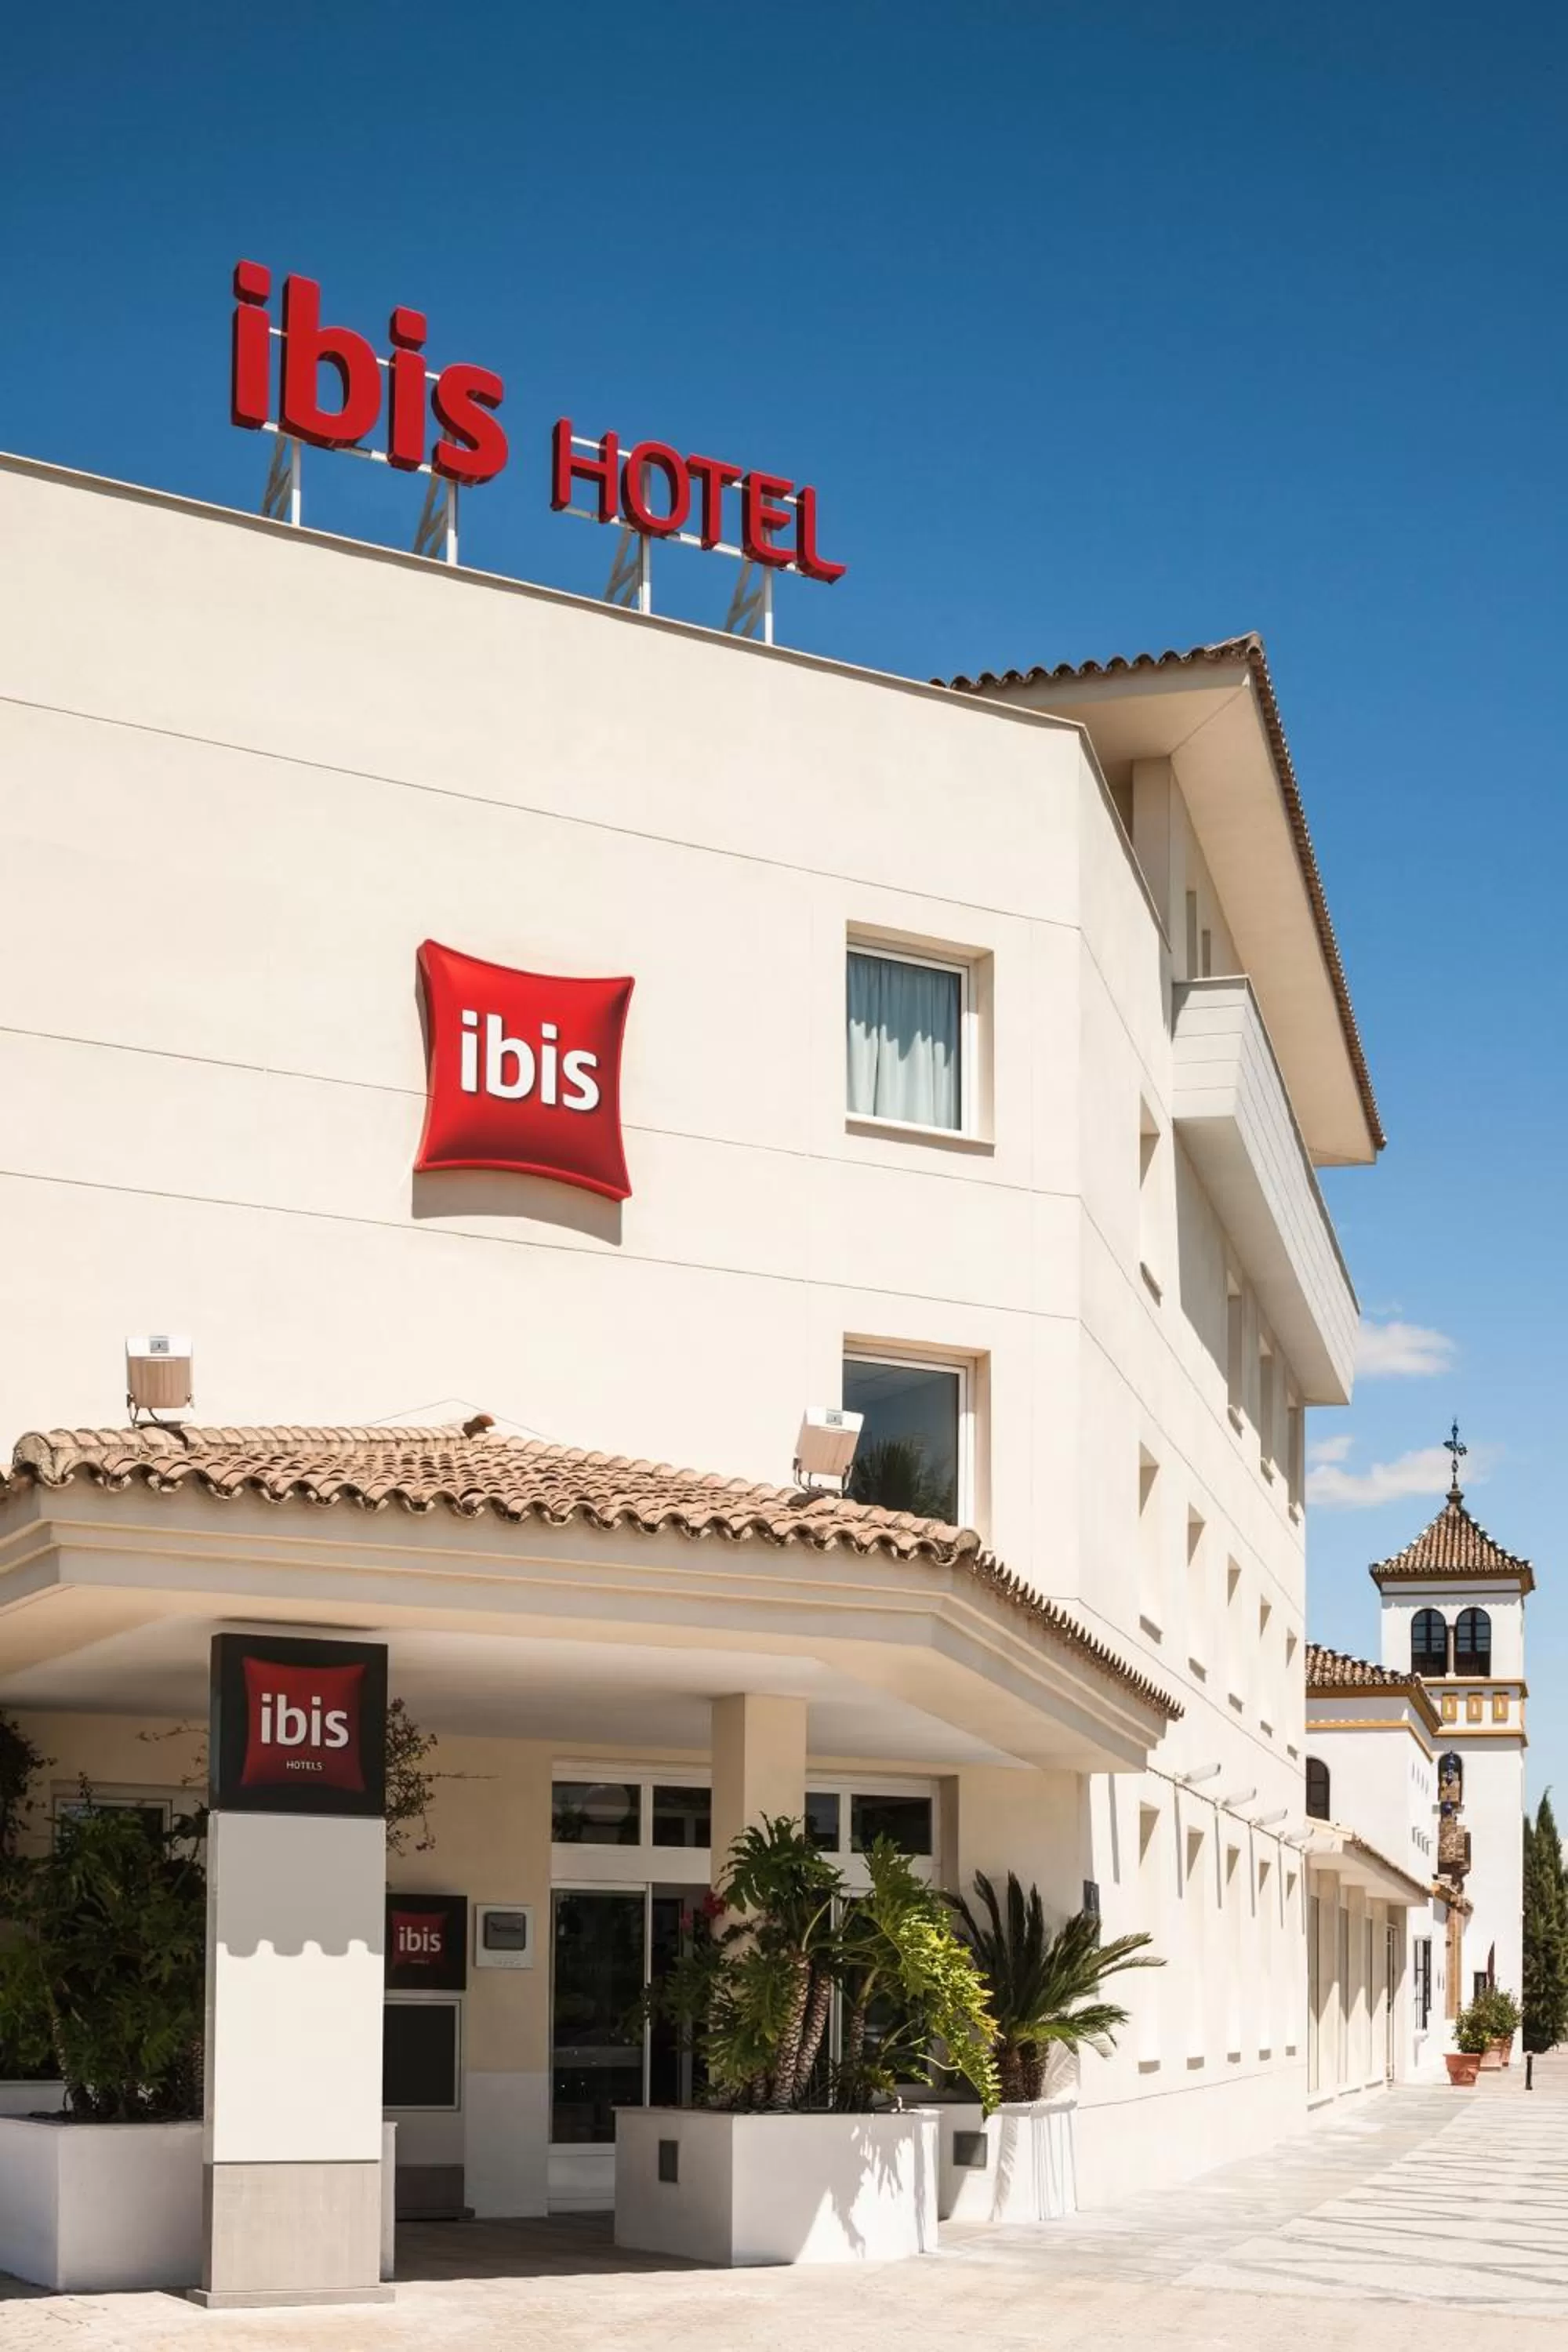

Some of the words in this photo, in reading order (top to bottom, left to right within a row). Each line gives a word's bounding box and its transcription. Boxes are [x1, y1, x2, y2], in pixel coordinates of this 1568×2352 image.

[232, 260, 509, 485] ibis
[550, 417, 847, 584] HOTEL
[461, 1009, 600, 1111] ibis
[261, 1693, 350, 1748] ibis
[286, 1760, 323, 1771] HOTELS
[398, 1926, 442, 1952] ibis
